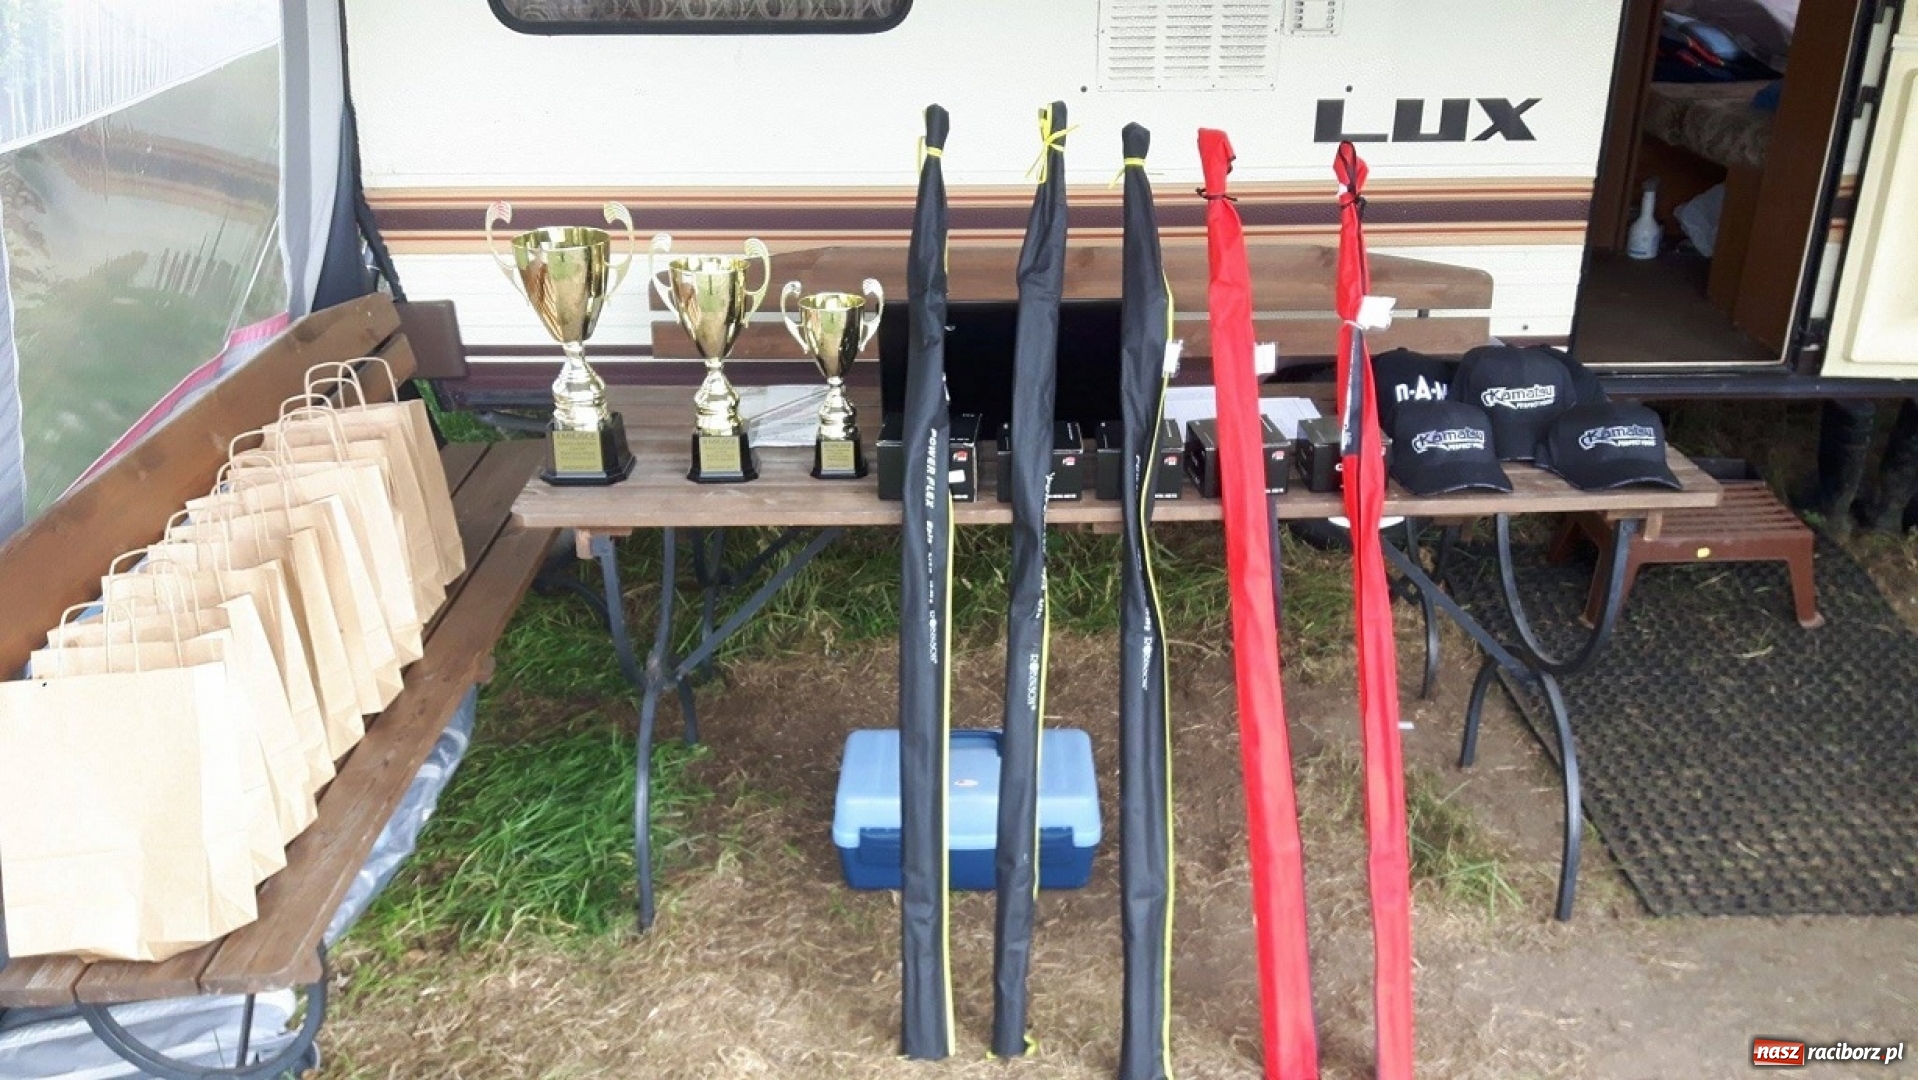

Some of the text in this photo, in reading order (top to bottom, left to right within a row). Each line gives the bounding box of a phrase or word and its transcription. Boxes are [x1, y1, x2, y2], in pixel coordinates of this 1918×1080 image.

[1314, 98, 1542, 142] LUX
[1481, 384, 1556, 407] Kamatsu
[1411, 426, 1485, 453] Kamatsu
[1578, 423, 1656, 449] Kamatsu
[926, 427, 938, 475] POWER
[925, 476, 936, 508] FLEX
